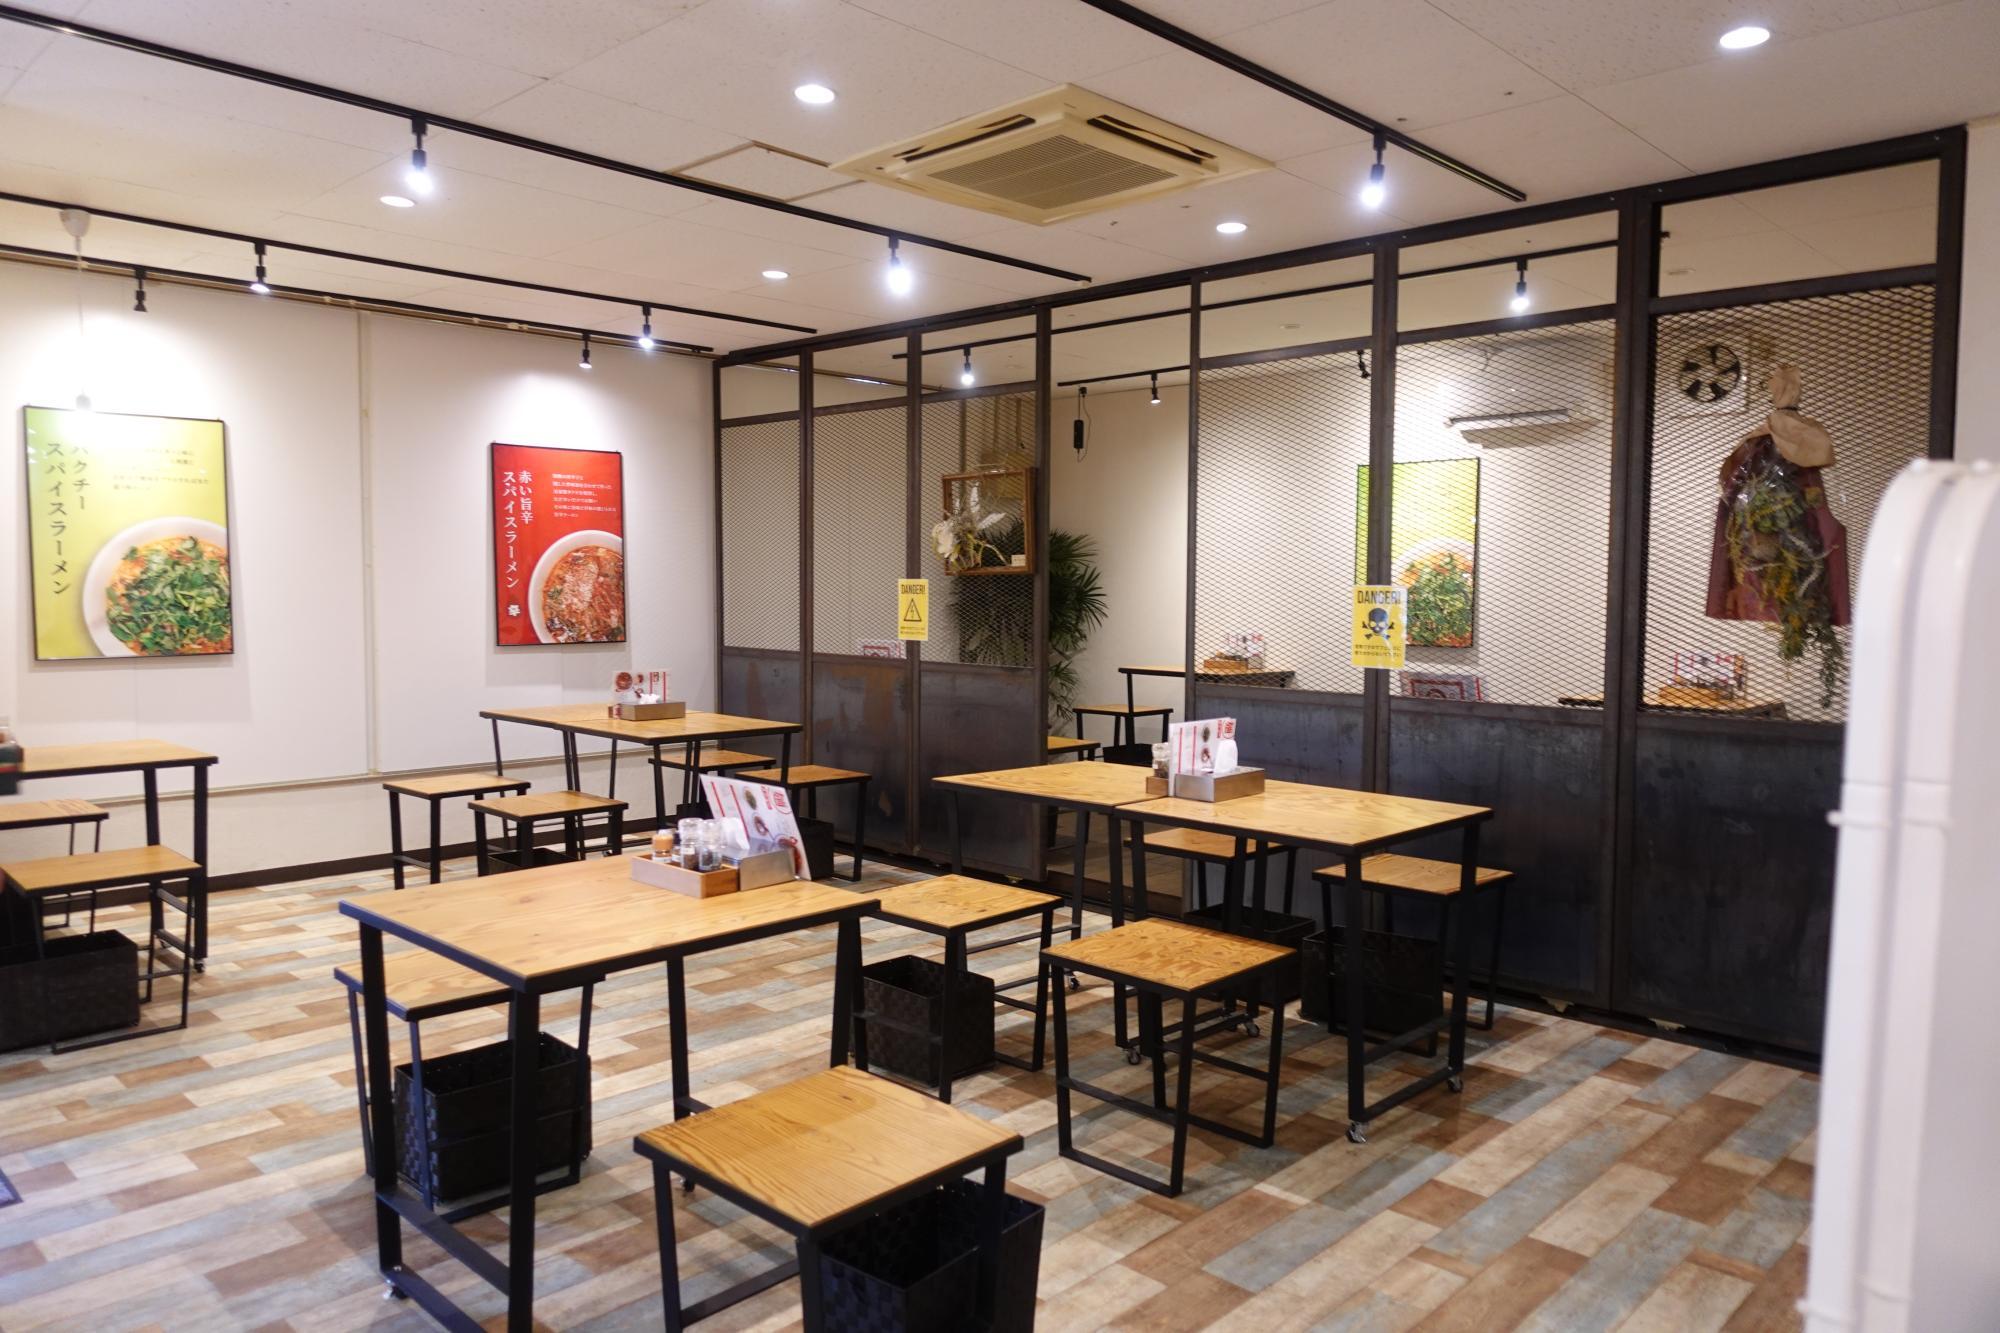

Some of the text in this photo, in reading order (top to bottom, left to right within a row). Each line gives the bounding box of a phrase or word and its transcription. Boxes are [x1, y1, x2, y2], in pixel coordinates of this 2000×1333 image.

[46, 442, 71, 595] スパイスラーメン
[518, 470, 534, 525] 赤い旨辛
[502, 471, 520, 589] スパイスラーメン
[901, 584, 926, 595] DANGER!
[1357, 590, 1402, 605] DANGER!
